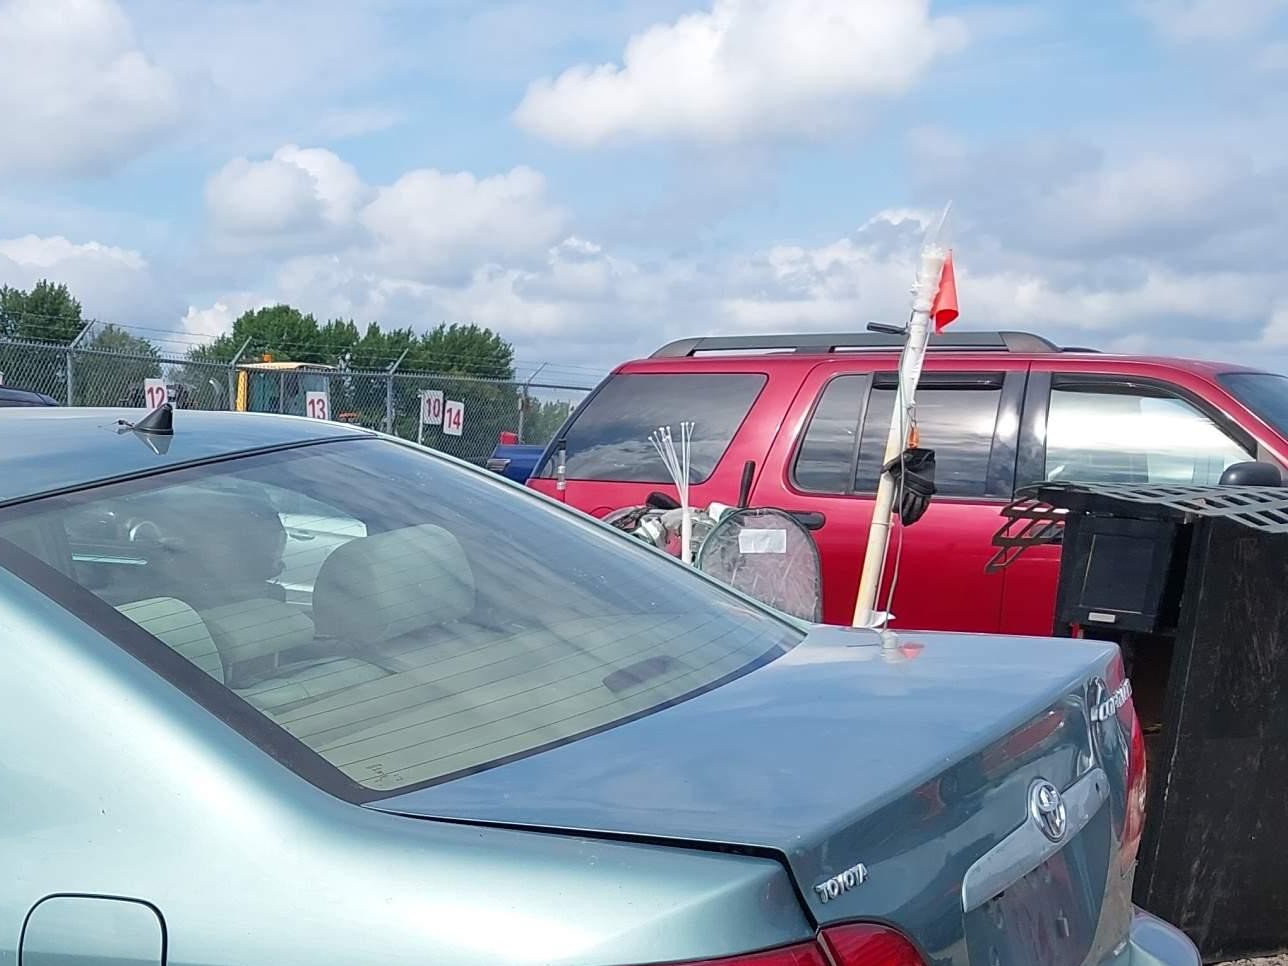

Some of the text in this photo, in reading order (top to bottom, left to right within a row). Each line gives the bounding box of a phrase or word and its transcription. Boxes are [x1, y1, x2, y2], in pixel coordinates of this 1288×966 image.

[147, 386, 166, 409] 12
[426, 398, 441, 418] 10
[308, 398, 327, 420] 13
[446, 407, 461, 429] 14
[815, 862, 869, 903] TOYOTA
